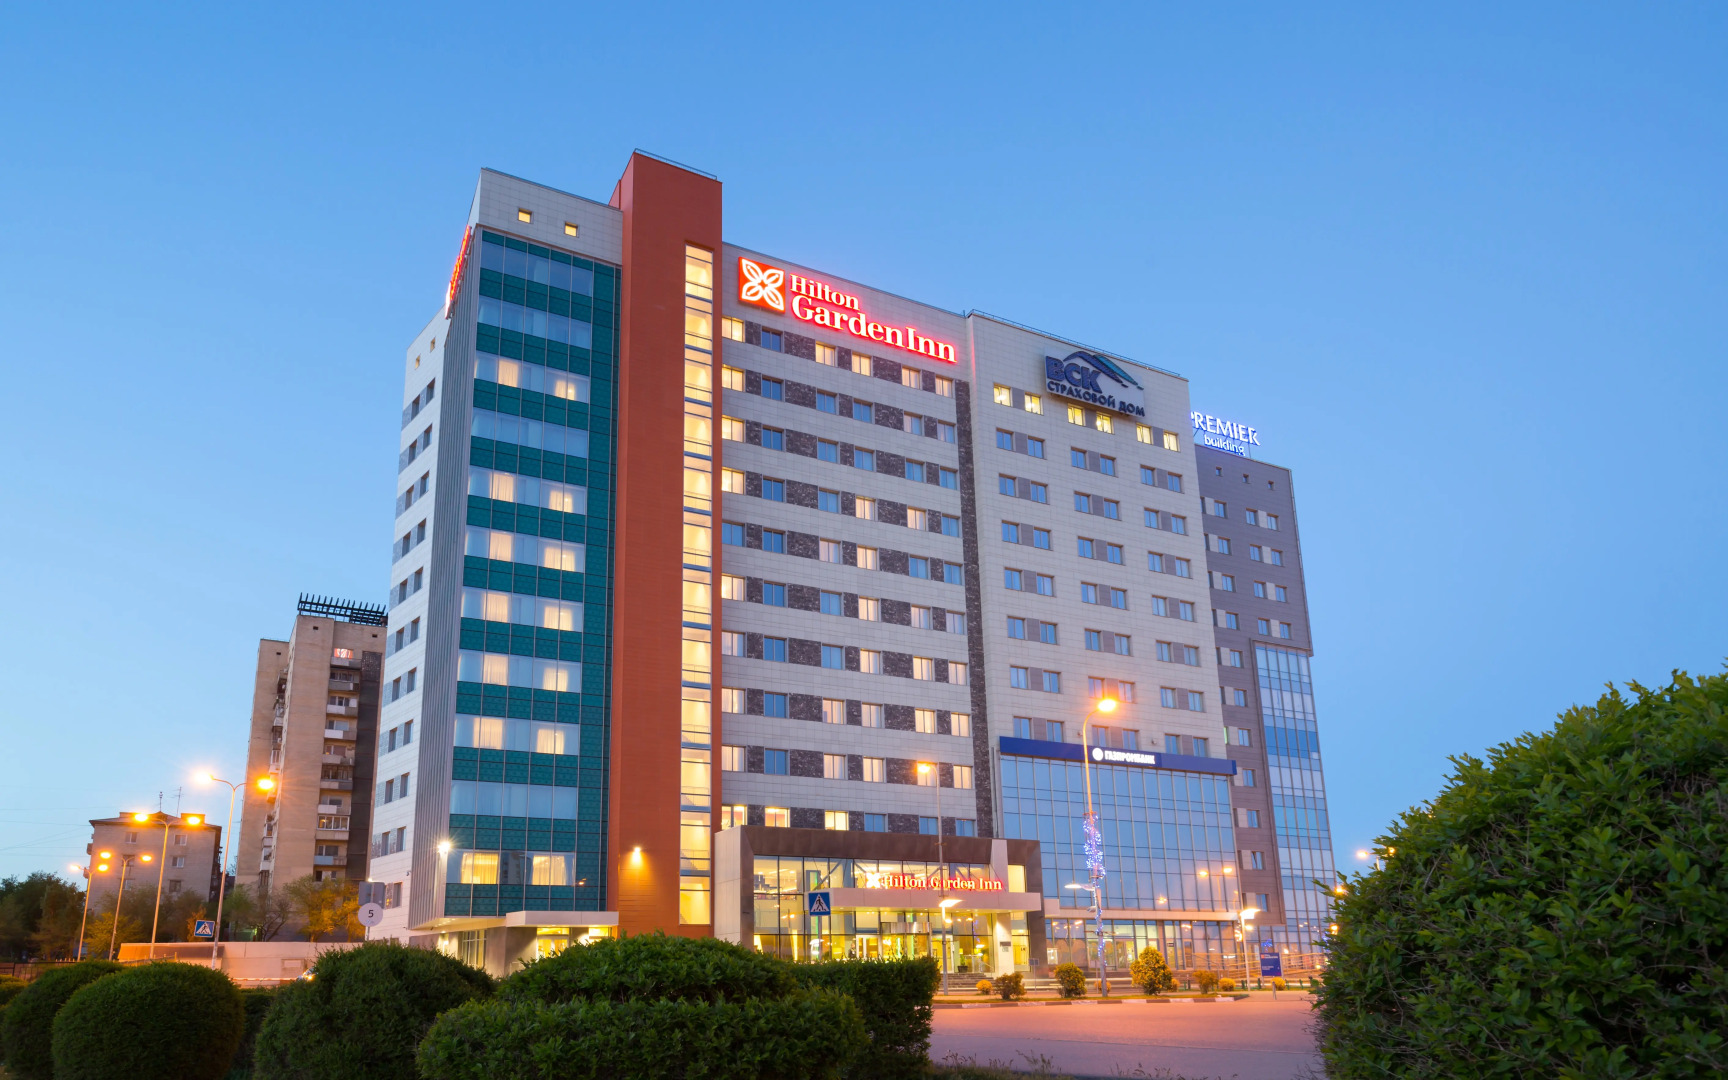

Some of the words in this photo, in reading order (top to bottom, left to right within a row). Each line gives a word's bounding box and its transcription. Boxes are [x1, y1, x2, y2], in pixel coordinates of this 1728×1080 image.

[790, 274, 860, 311] Hilton
[792, 295, 904, 347] Garden
[906, 327, 957, 363] Inn
[1045, 355, 1103, 394] ВСК
[1047, 380, 1116, 409] СТРАХОВОЙ
[1118, 400, 1145, 417] ДОМ
[1204, 434, 1246, 457] building
[883, 874, 926, 888] Hilton
[979, 878, 1003, 890] Inn
[368, 909, 374, 918] 5
